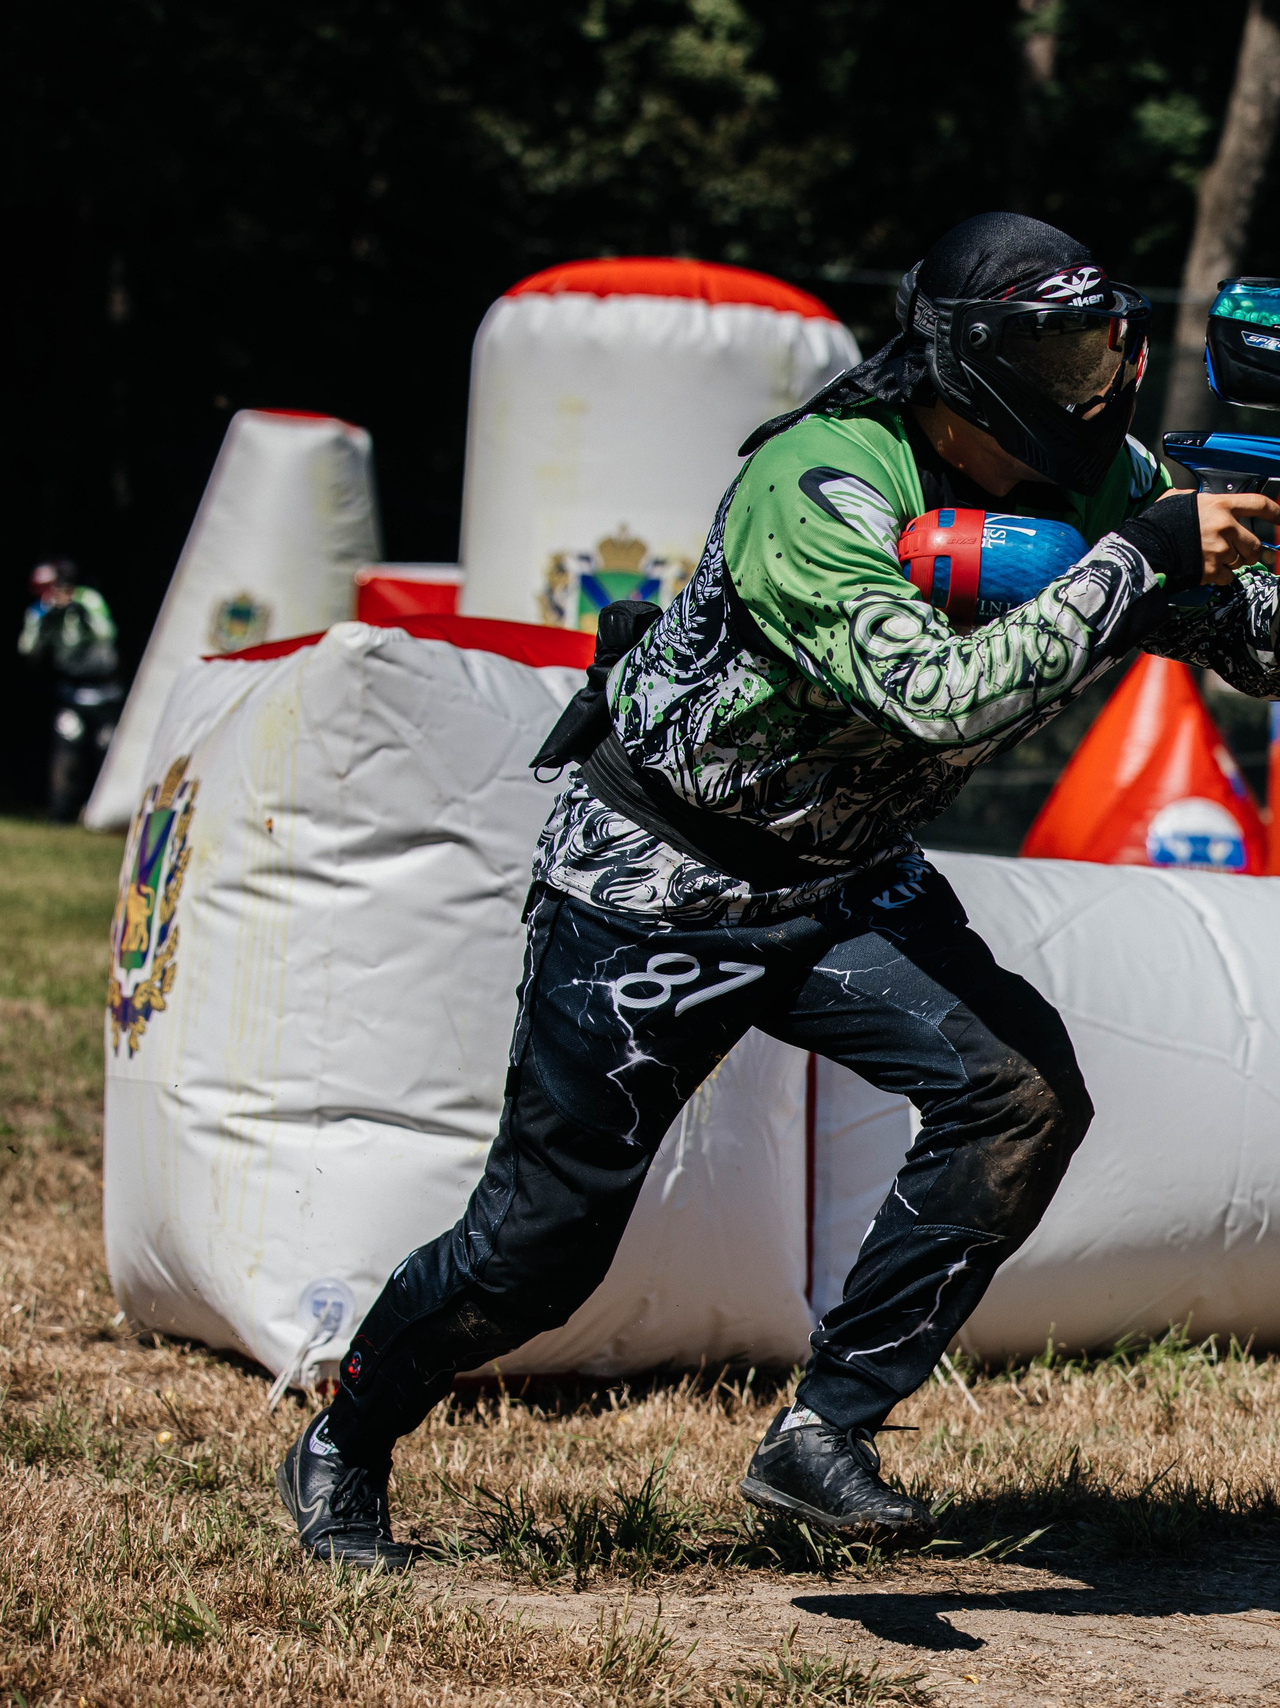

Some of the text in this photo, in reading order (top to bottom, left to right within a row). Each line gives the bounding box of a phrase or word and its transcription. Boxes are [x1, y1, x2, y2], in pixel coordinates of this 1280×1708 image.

[1067, 293, 1104, 307] lken
[798, 854, 851, 866] dye
[615, 952, 766, 1018] 87
